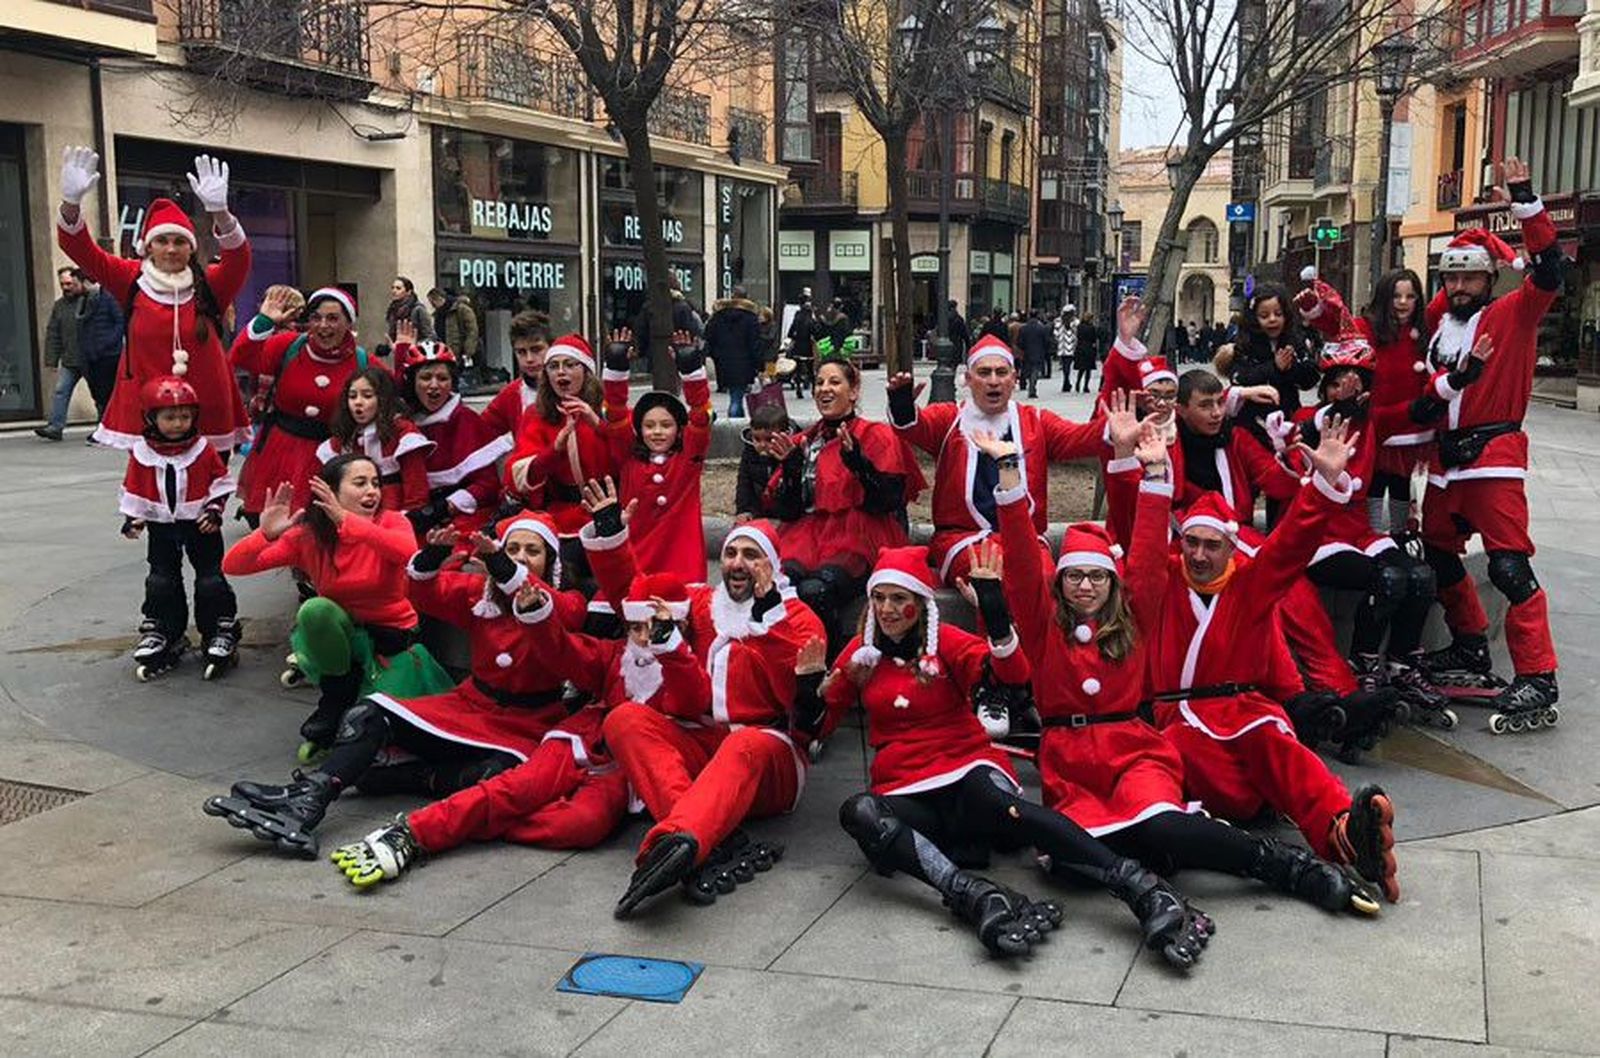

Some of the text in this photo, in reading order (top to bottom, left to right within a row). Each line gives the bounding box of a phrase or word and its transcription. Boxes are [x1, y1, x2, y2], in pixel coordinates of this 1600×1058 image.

[472, 199, 552, 232] REBAJAS
[723, 186, 731, 223] SE
[624, 215, 683, 243] REJAS
[459, 258, 565, 289] POR CIERRE
[614, 265, 643, 291] POR
